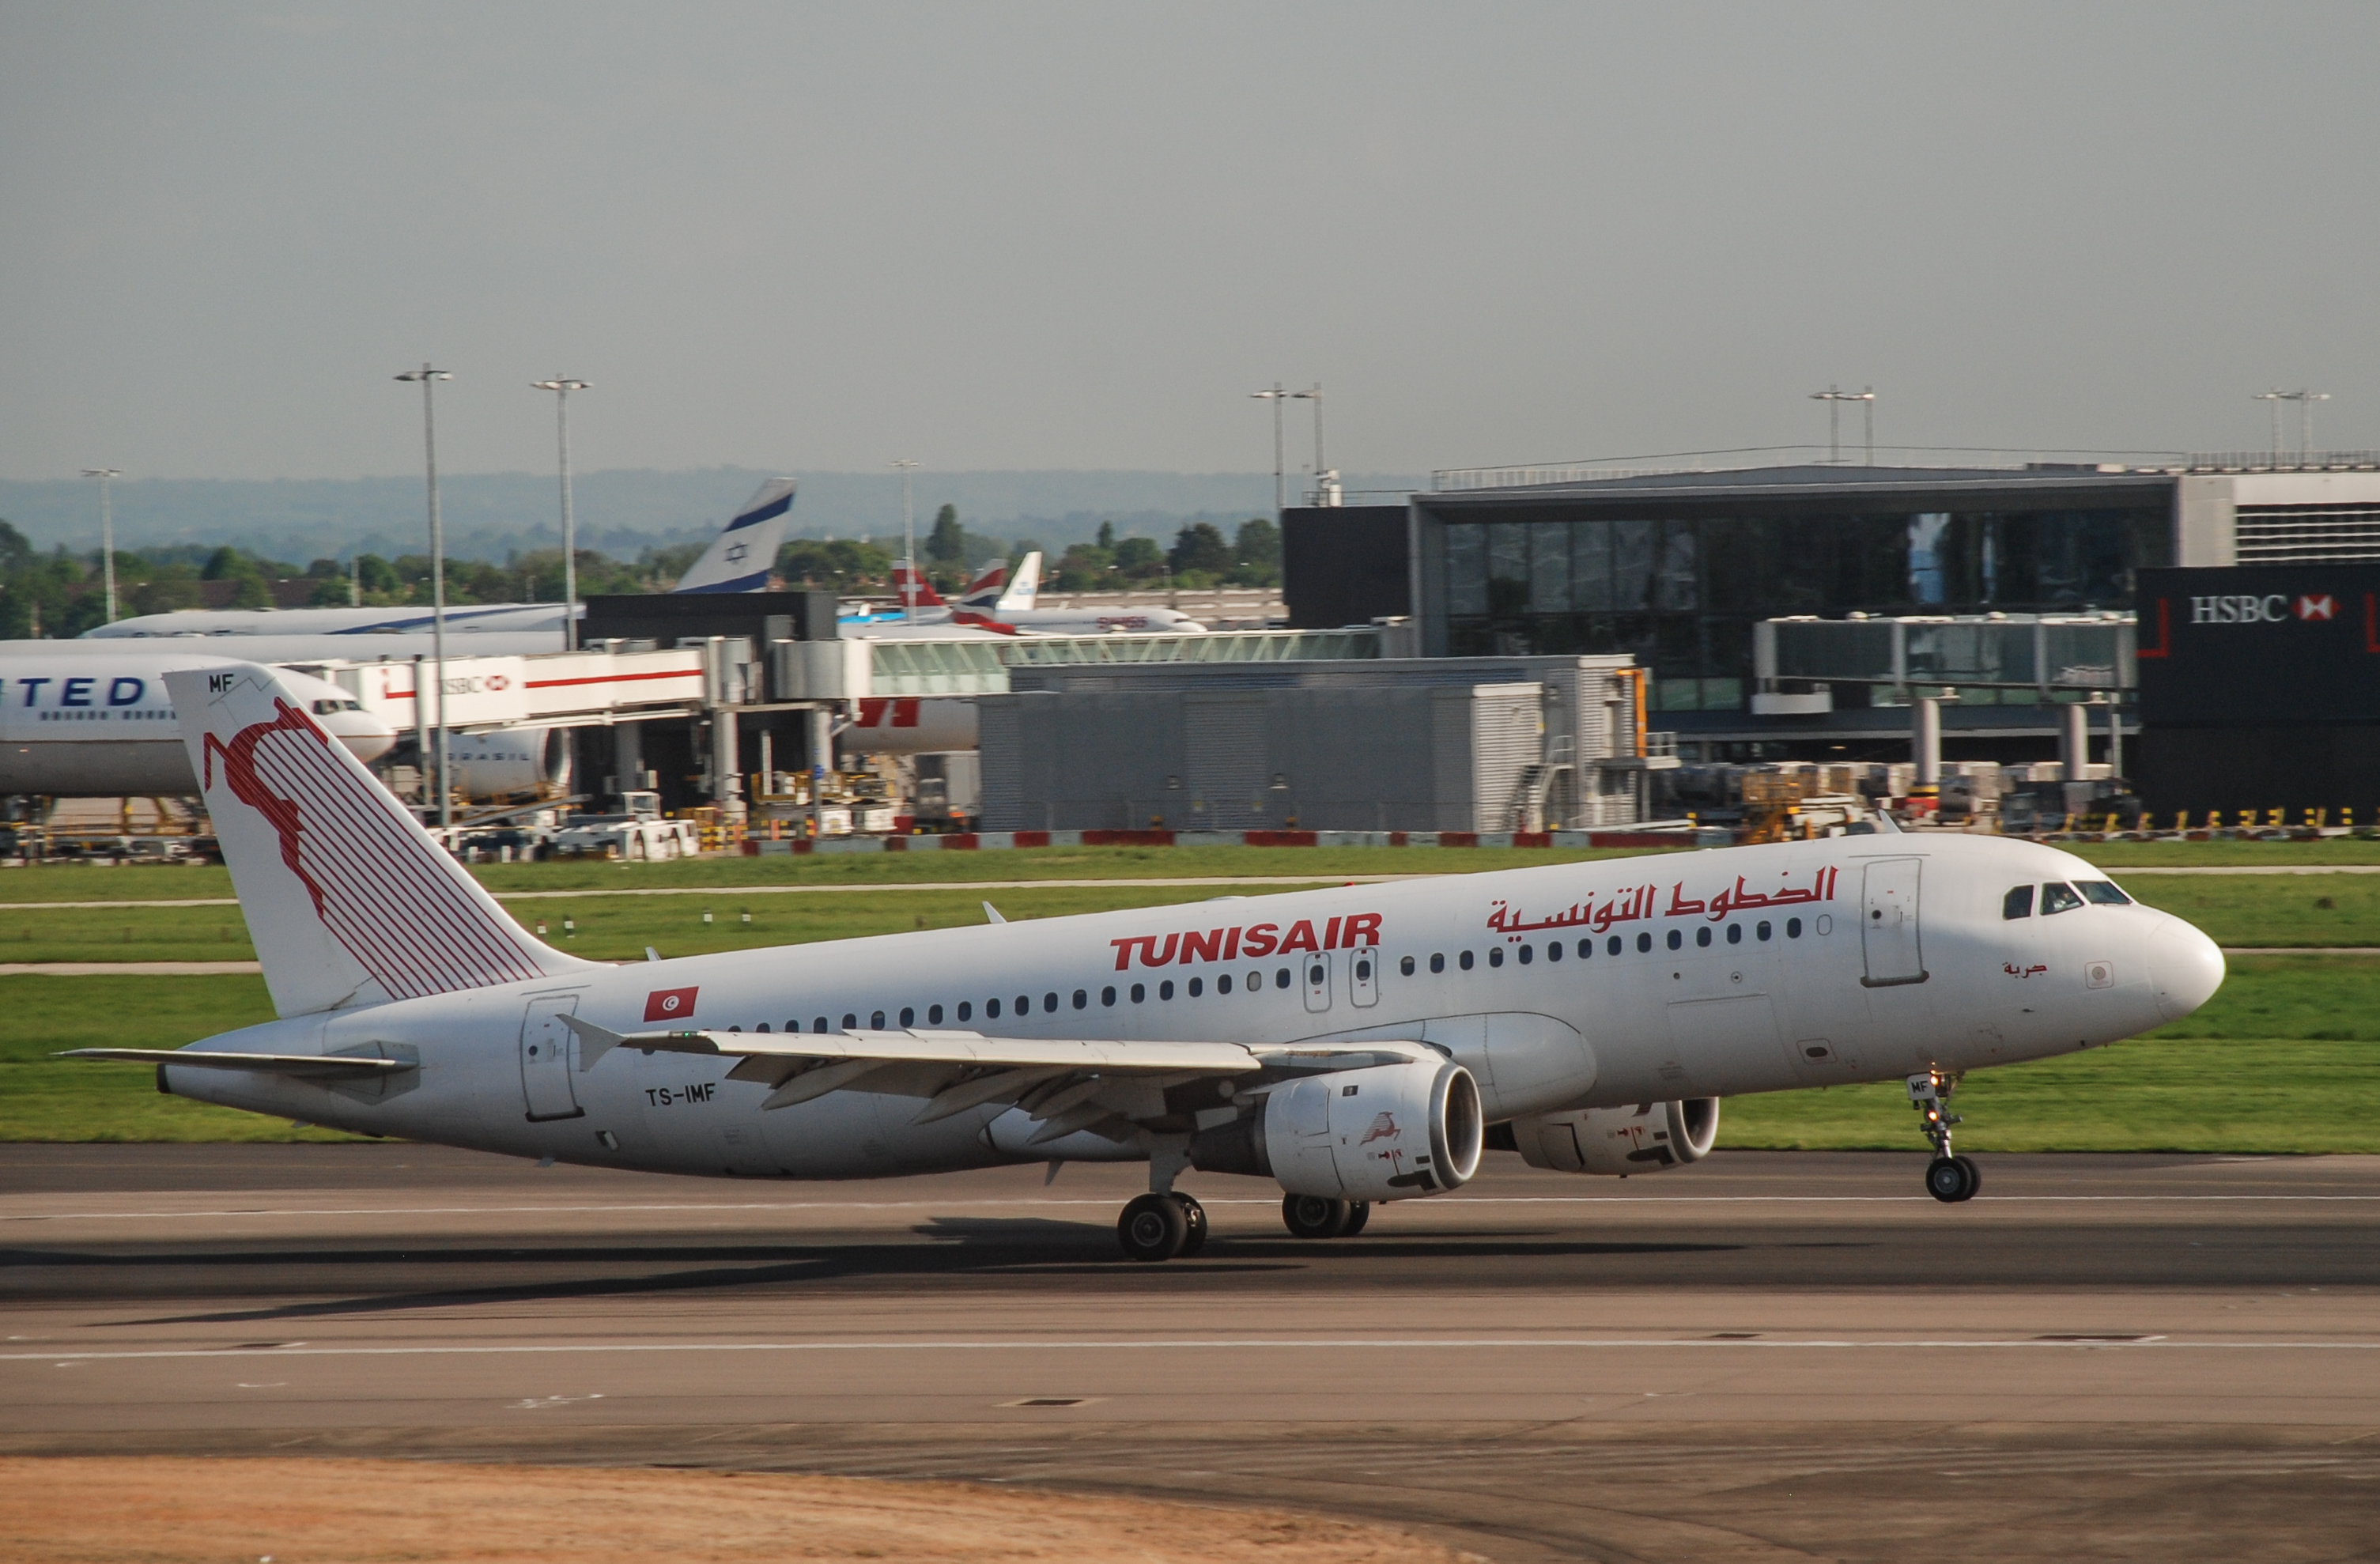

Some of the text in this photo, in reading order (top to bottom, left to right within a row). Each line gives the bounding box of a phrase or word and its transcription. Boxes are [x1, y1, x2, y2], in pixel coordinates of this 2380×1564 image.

[2189, 595, 2289, 624] HSBC
[0, 677, 147, 708] TED
[209, 673, 234, 693] MF
[1486, 865, 1839, 943] الخطوط التونسية
[1109, 912, 1383, 971] TUNISAIR
[2002, 961, 2048, 979] جربة
[645, 1082, 716, 1106] TS-IMF
[1911, 1080, 1928, 1093] MF
